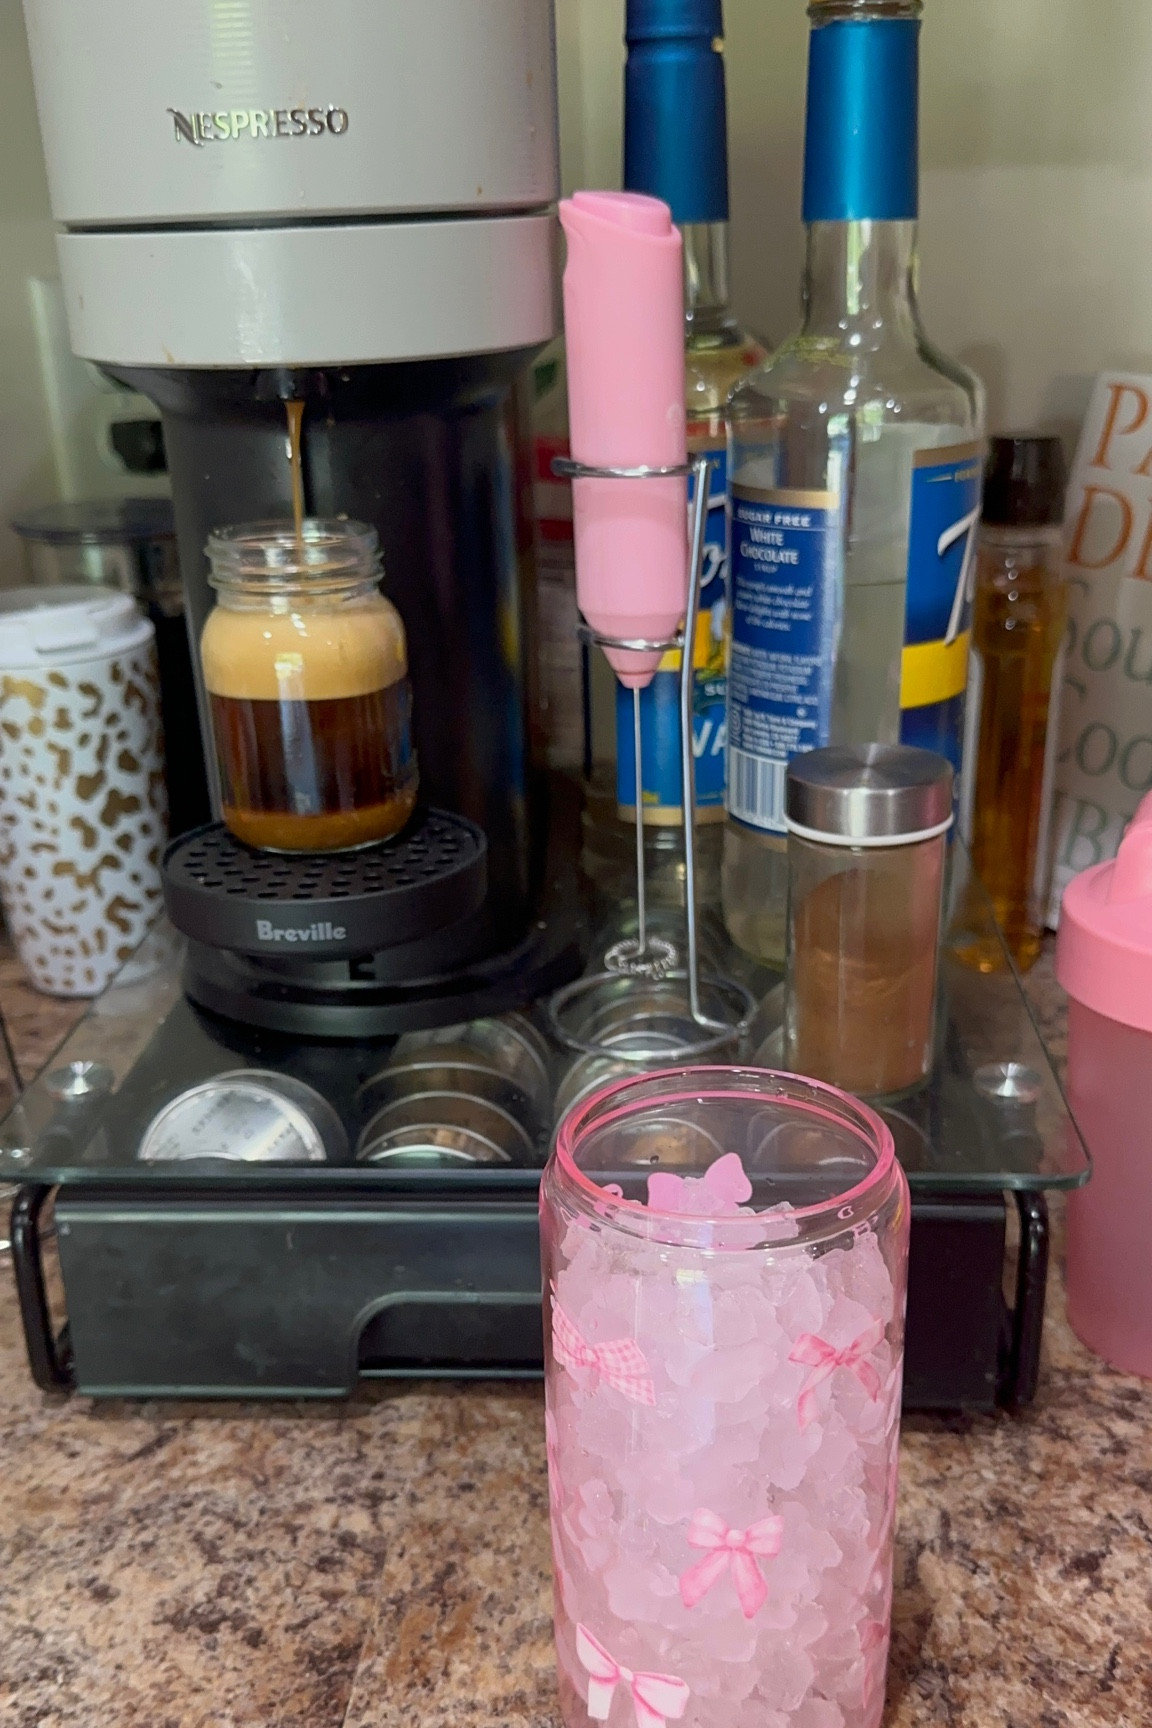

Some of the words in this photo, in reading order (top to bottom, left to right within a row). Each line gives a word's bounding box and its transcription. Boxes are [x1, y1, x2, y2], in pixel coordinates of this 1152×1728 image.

[167, 103, 349, 147] NESPRESSO
[738, 508, 771, 524] SUGAR
[774, 512, 811, 528] FREE
[256, 919, 347, 942] Breville
